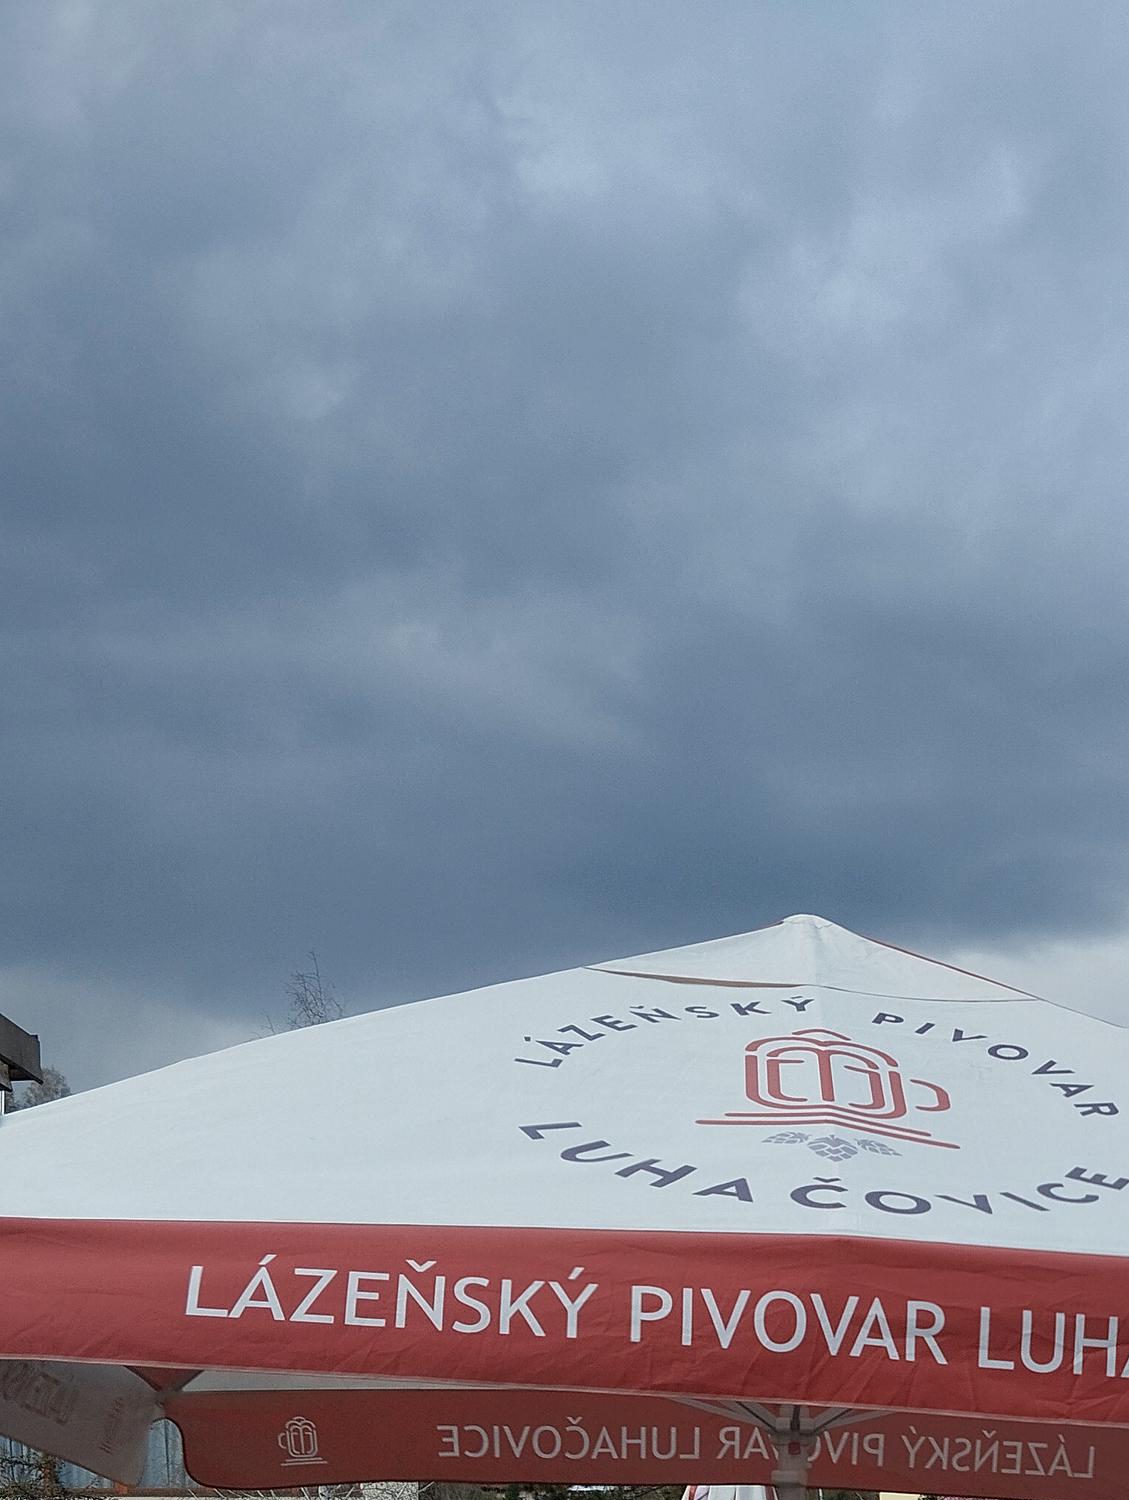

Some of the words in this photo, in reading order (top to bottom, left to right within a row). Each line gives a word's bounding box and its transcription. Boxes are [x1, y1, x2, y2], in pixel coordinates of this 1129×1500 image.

[514, 996, 815, 1069] LÁZEŇSKÝ
[871, 1011, 1119, 1117] PIVOVAR
[184, 1255, 599, 1339] LÁZEŇSKÝ
[629, 1283, 947, 1367] PIVOVAR
